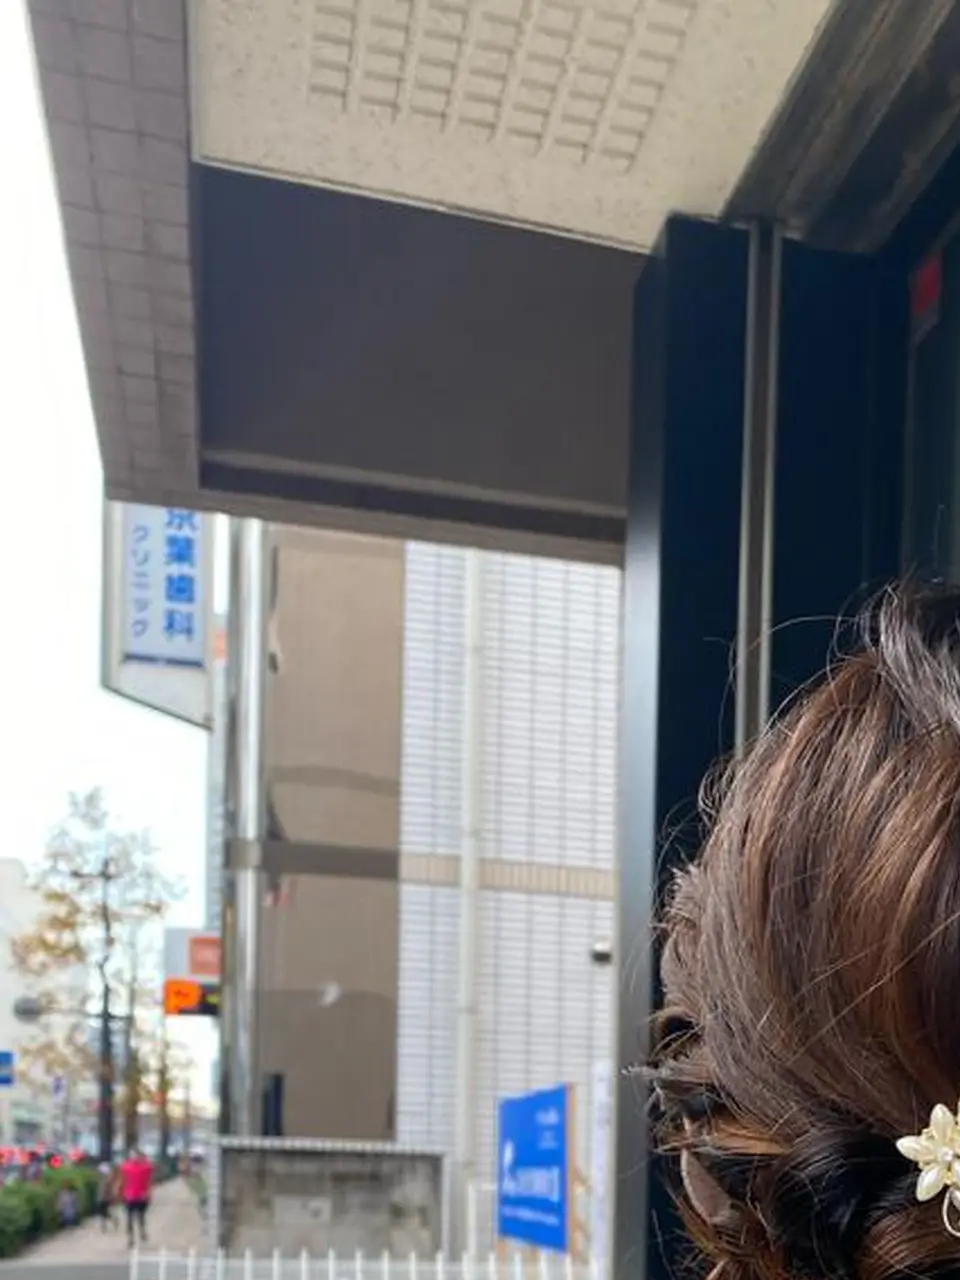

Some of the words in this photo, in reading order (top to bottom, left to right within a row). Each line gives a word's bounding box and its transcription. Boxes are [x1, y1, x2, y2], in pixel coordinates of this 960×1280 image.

[131, 524, 150, 638] クリニック
